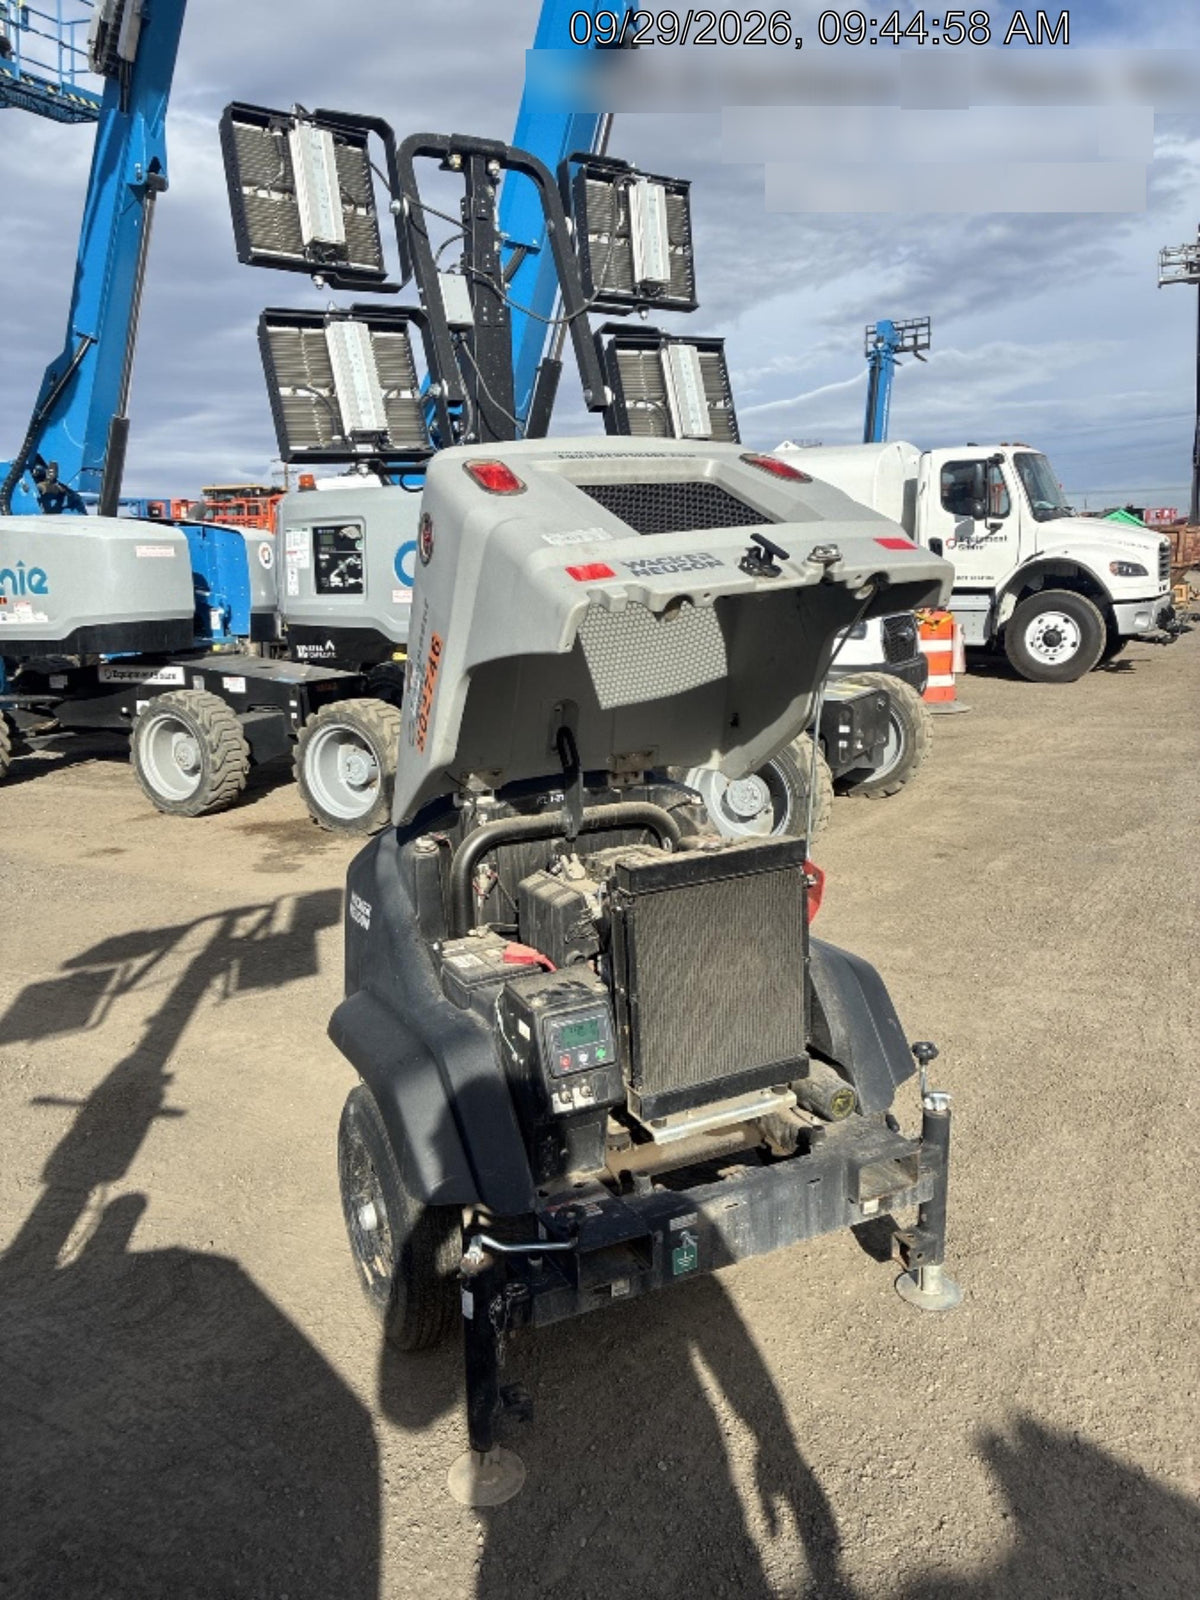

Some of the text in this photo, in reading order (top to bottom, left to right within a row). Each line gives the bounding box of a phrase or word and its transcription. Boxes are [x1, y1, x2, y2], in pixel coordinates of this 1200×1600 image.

[620, 552, 715, 569] WACKER
[631, 560, 725, 578] NEUSON
[0, 560, 49, 596] nie
